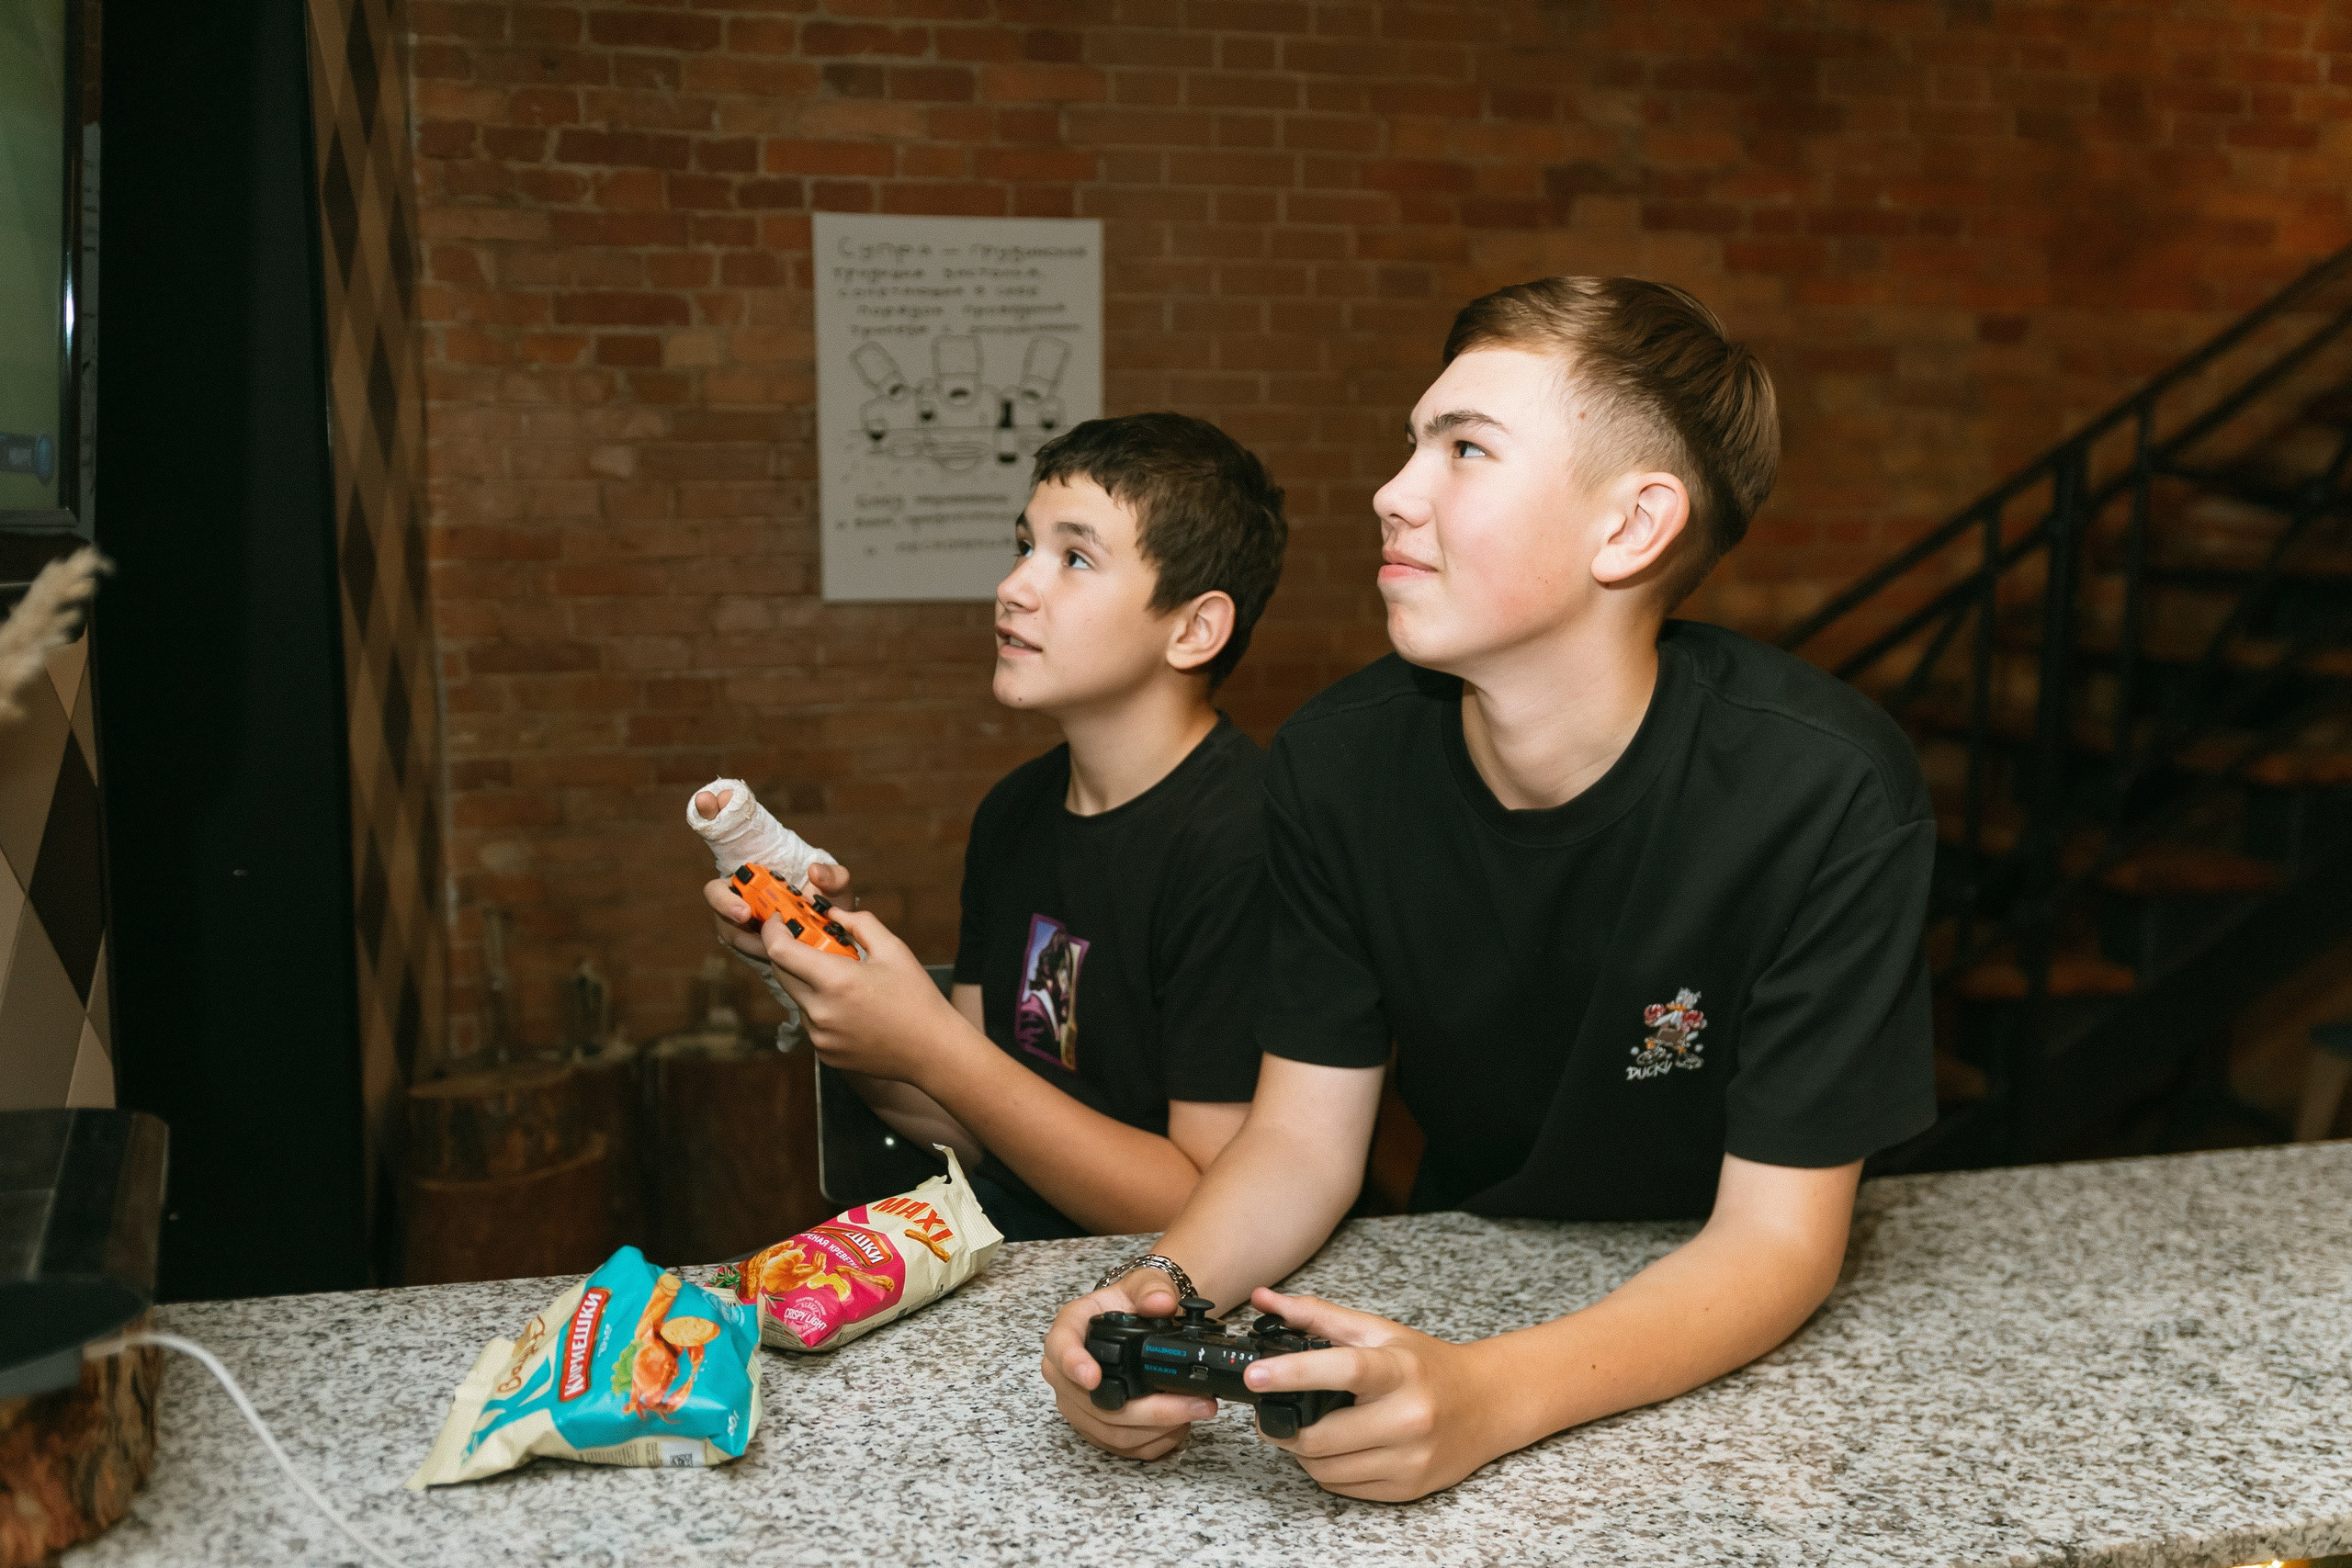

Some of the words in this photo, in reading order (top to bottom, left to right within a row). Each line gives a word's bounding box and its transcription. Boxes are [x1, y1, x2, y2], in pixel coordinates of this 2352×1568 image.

[871, 1197, 954, 1242] MAXI
[828, 1243, 862, 1270] КРЕВЕТК
[784, 1307, 808, 1321] CRISPY
[805, 1314, 828, 1331] LIGHT
[563, 1292, 604, 1397] КИРИЕШКИ
